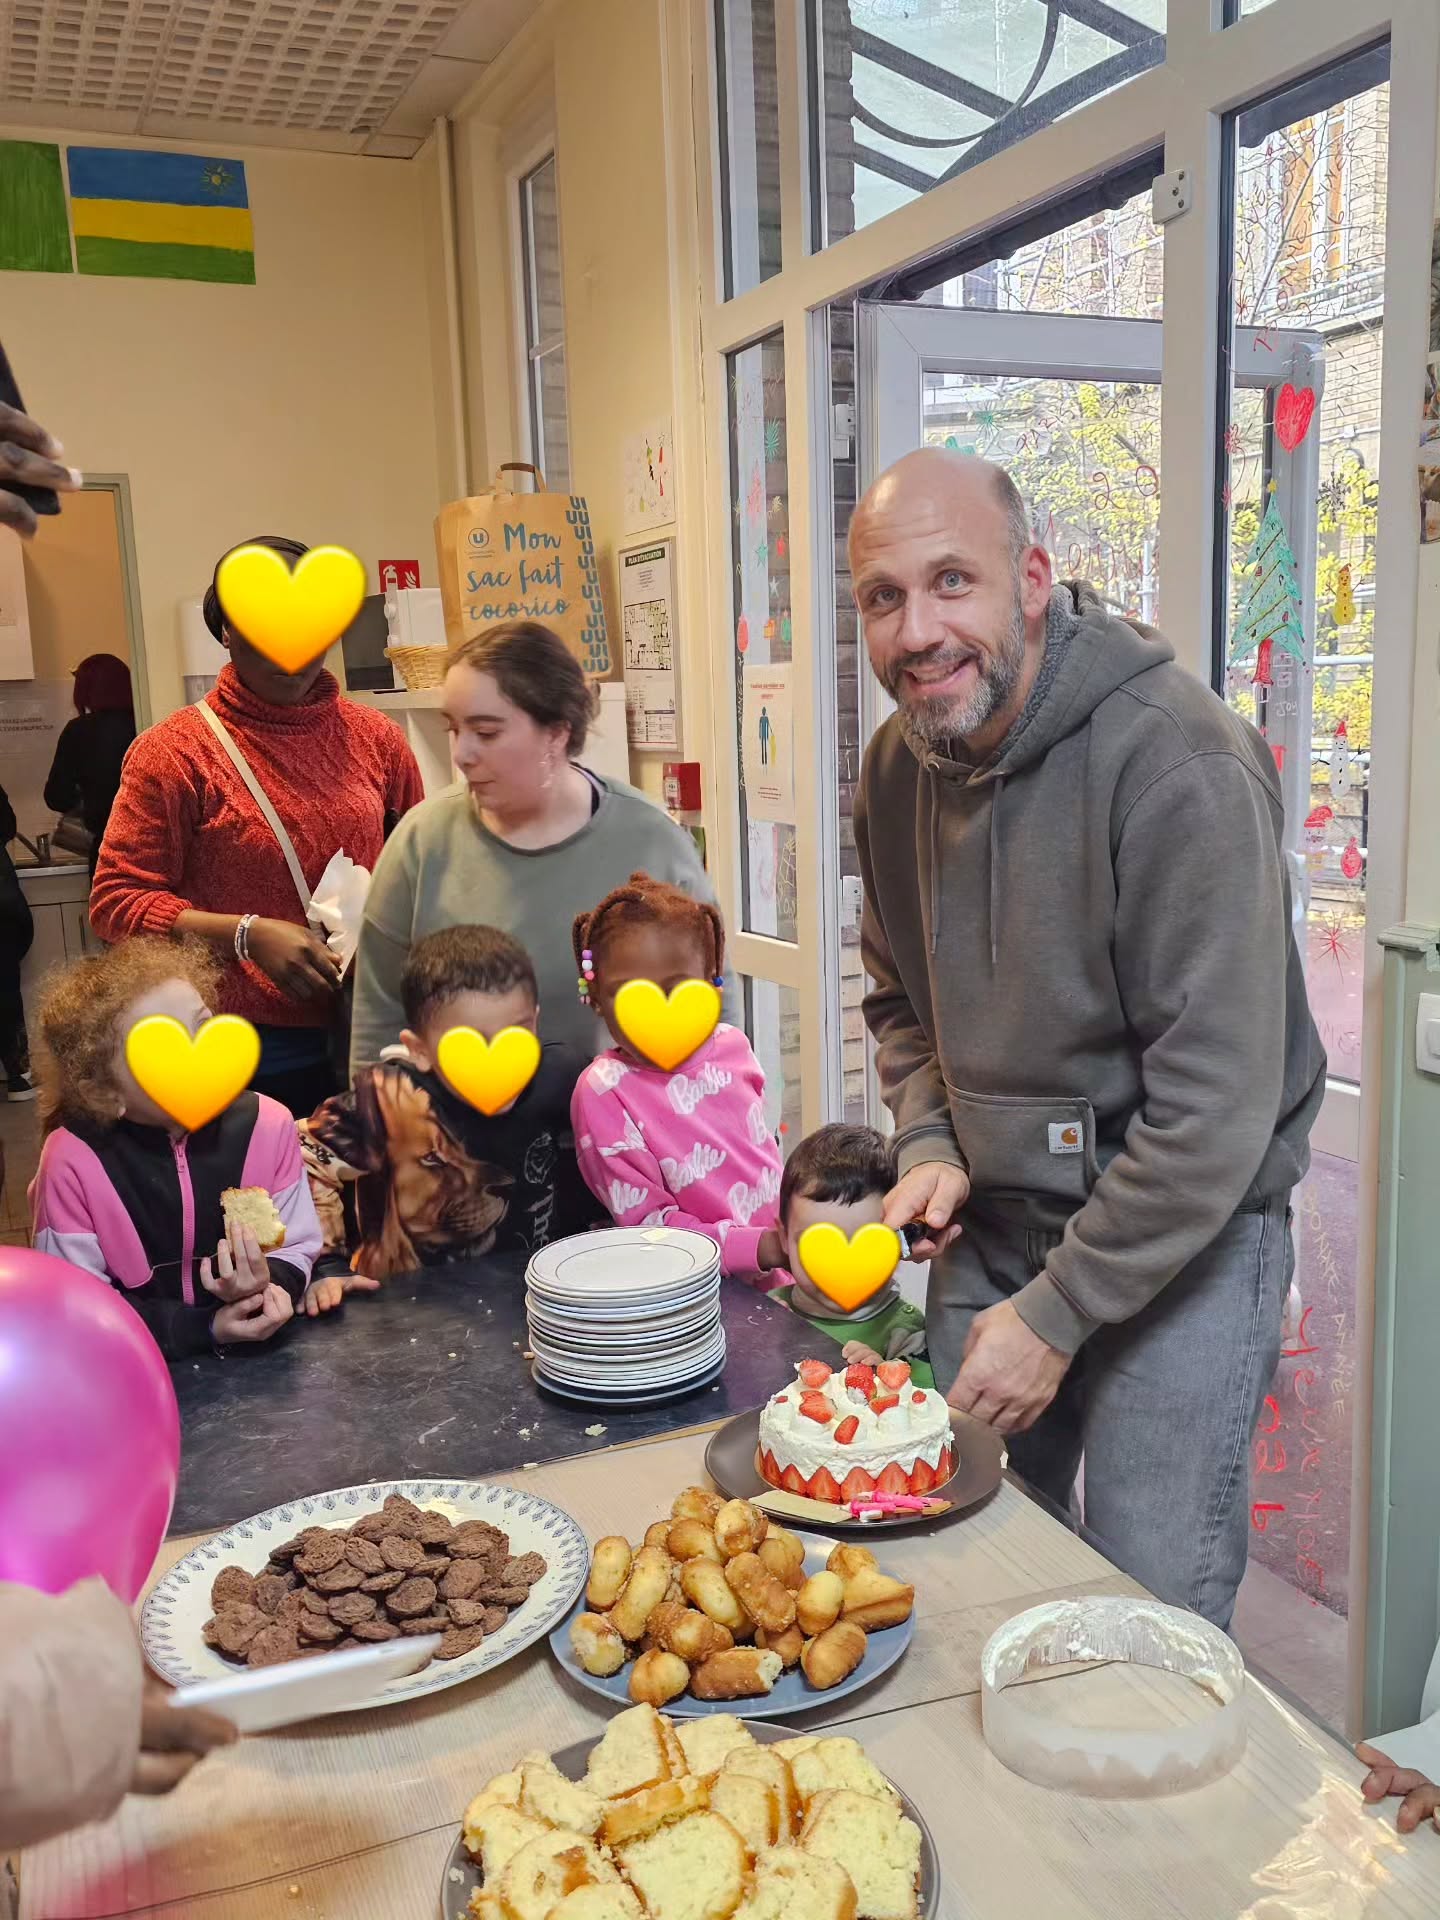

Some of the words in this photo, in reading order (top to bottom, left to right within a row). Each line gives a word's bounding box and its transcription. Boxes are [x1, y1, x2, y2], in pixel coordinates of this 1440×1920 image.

[503, 523, 561, 552] Mon
[467, 570, 512, 592] sac
[519, 556, 565, 595] fait
[464, 596, 570, 620] cocorico
[667, 1062, 732, 1114] Barbie
[659, 1142, 727, 1193] Barbie
[612, 1178, 649, 1215] bie
[1252, 1395, 1286, 1532] 026
